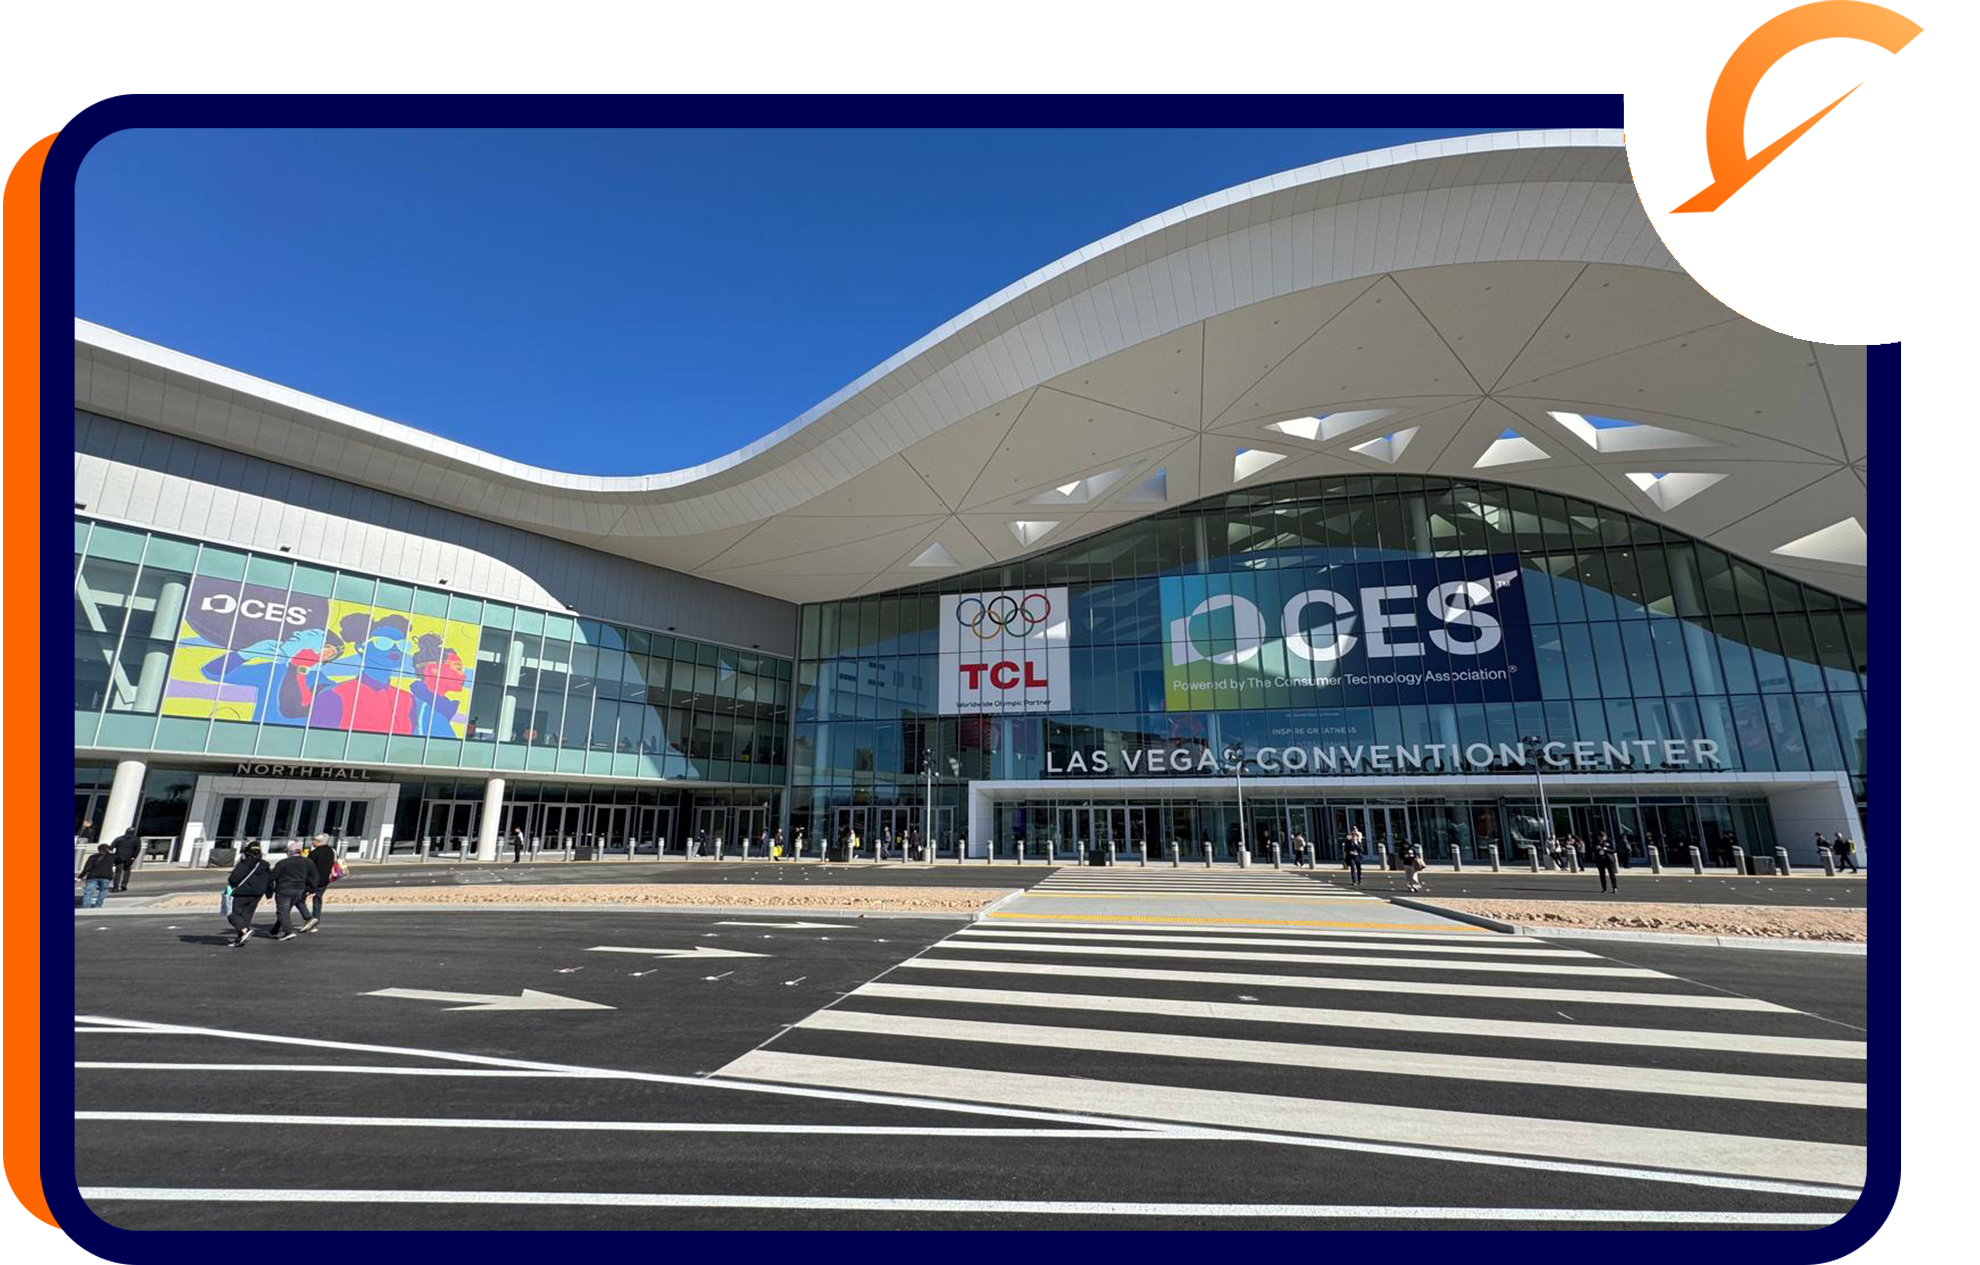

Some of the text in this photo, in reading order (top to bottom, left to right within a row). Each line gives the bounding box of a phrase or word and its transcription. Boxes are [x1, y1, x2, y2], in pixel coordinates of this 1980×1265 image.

[240, 599, 307, 625] CES
[1280, 580, 1502, 662] CES
[959, 660, 1048, 689] TCL
[1173, 680, 1227, 691] Powered
[1230, 679, 1245, 691] by
[1247, 677, 1272, 689] The
[1274, 675, 1342, 688] Consumer
[1344, 671, 1422, 686] Technology
[1046, 738, 1721, 772] LAS VEGAS CONVENTION CENTER
[237, 763, 371, 780] NORTH HALL
